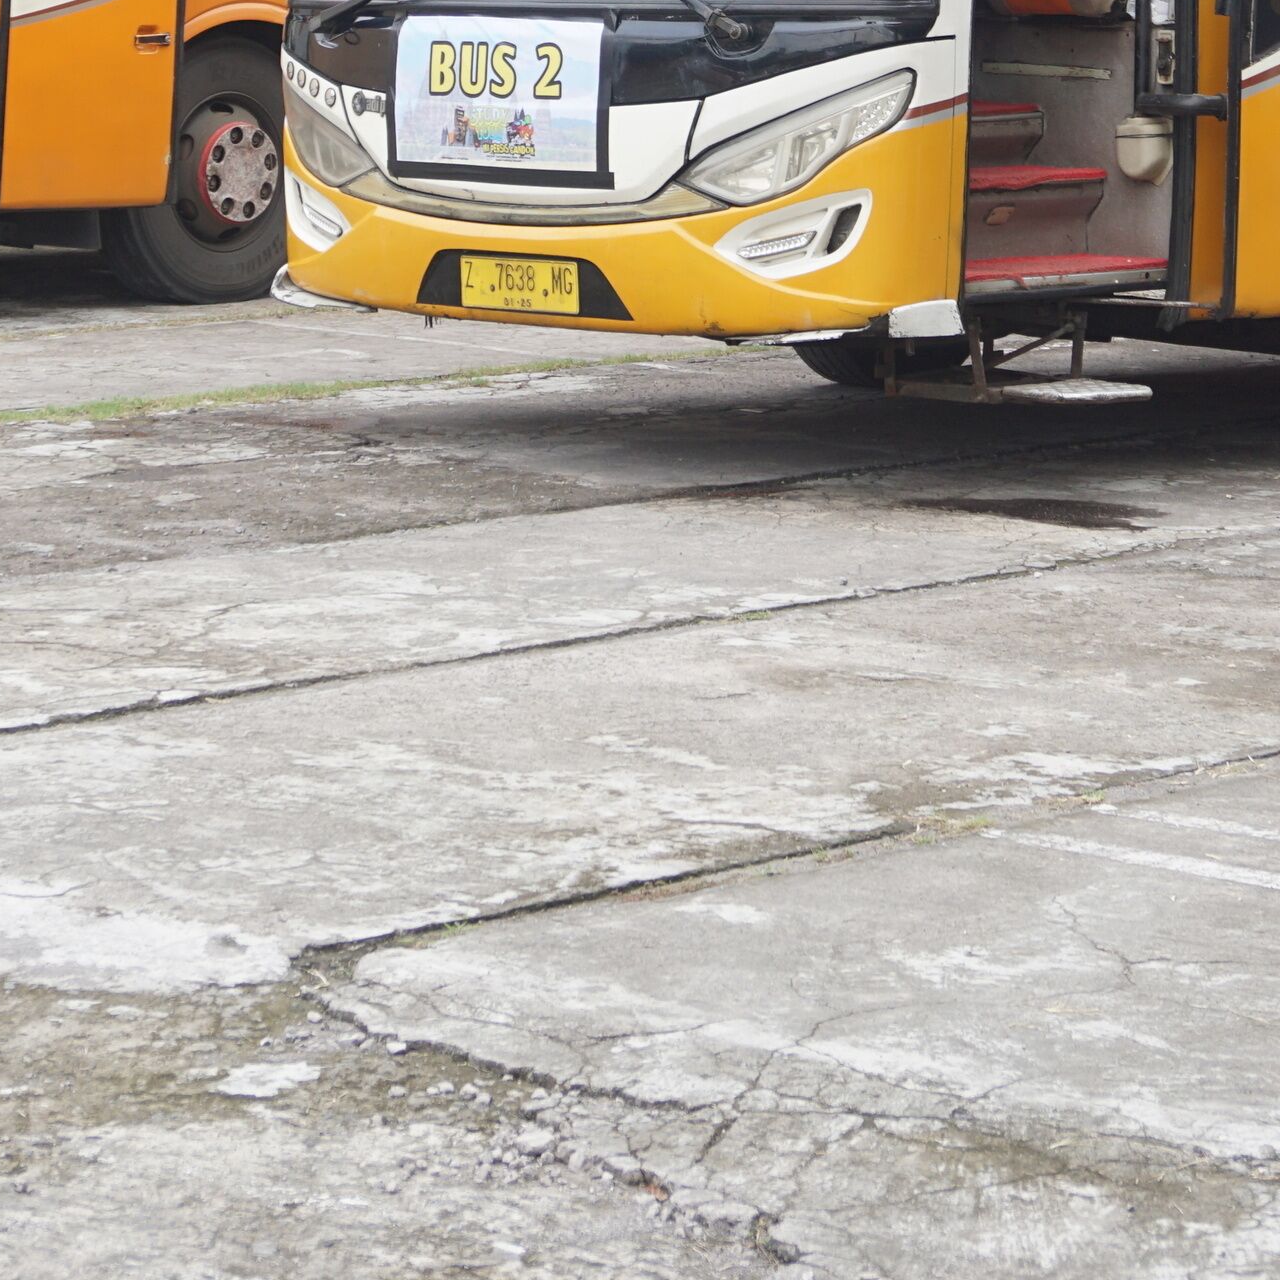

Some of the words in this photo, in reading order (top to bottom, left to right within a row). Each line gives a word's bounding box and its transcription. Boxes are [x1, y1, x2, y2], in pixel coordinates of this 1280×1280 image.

[429, 40, 517, 98] BUS
[533, 42, 563, 100] 2
[464, 261, 475, 289] Z
[495, 263, 536, 292] 7638
[551, 266, 573, 296] MG
